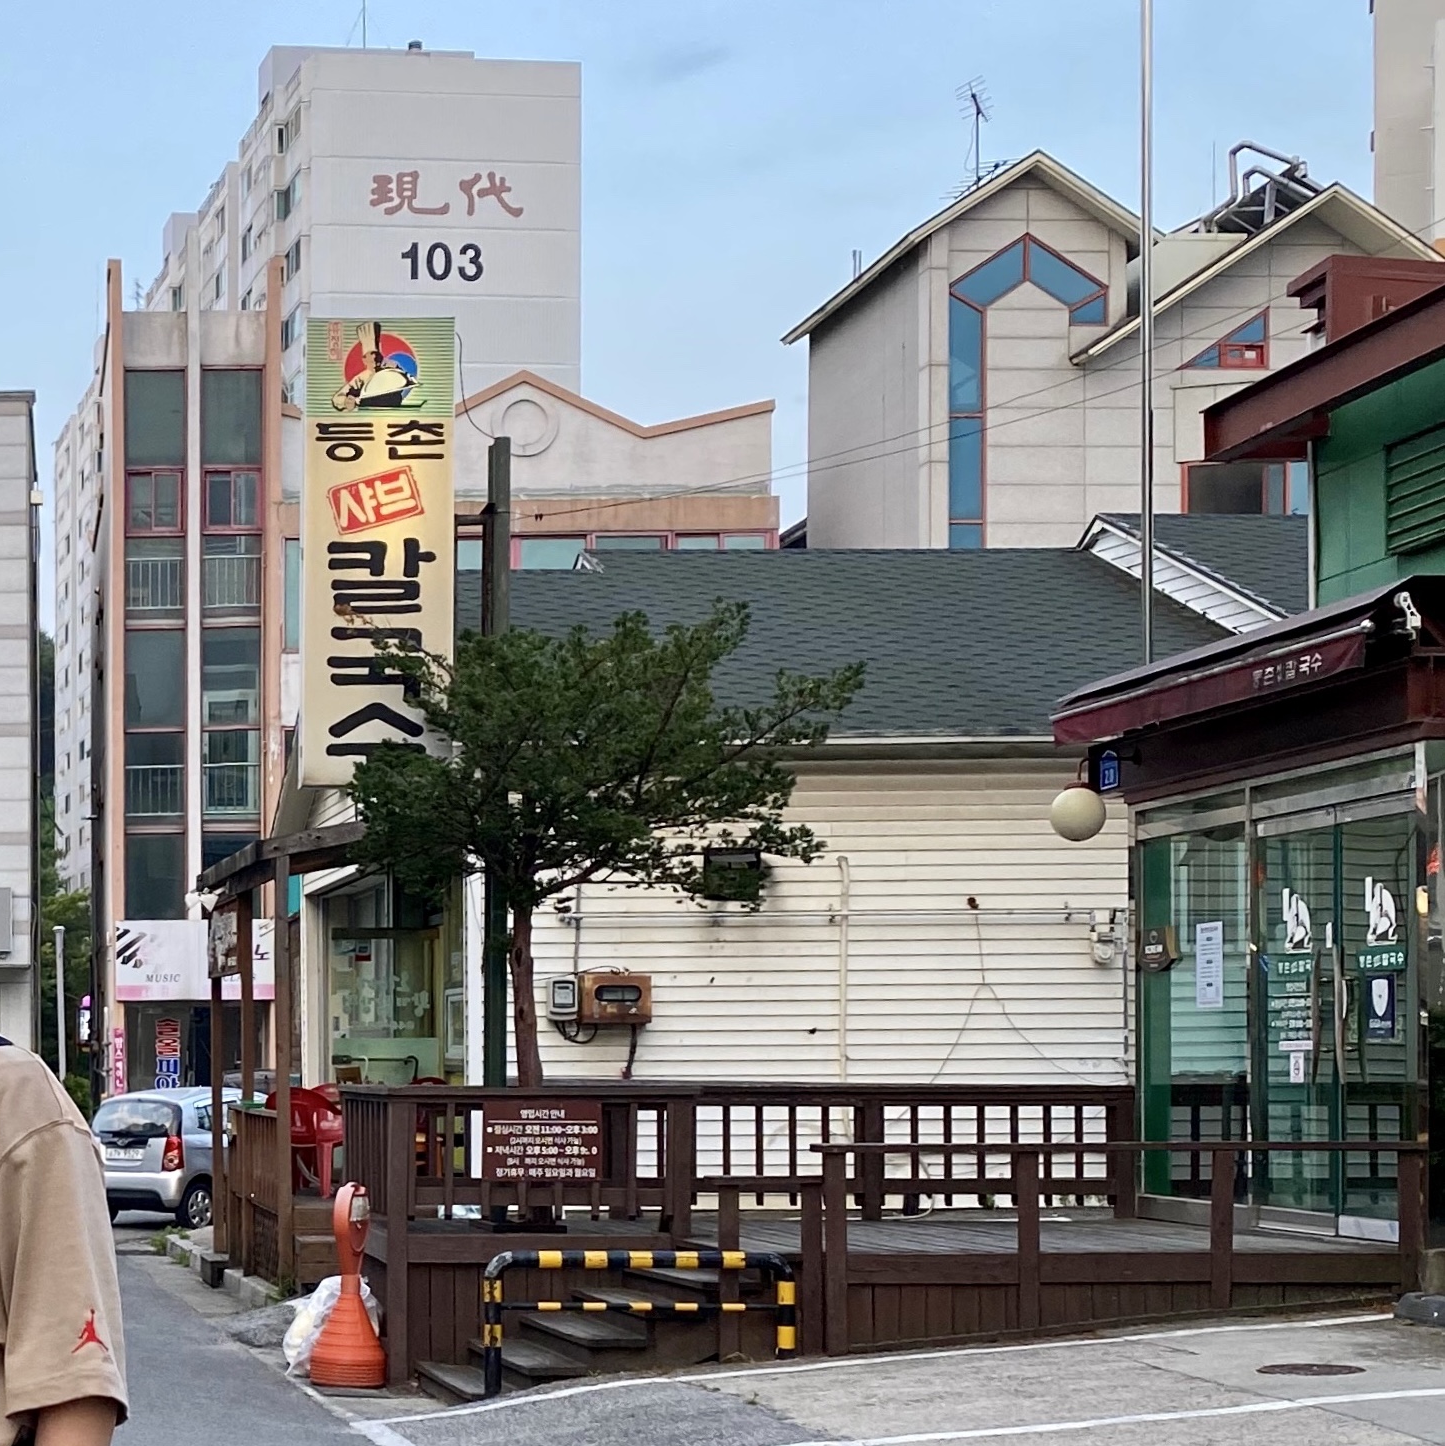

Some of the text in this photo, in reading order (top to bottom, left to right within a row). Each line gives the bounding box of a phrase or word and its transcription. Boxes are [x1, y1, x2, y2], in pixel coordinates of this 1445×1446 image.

[369, 170, 524, 218] 現代
[401, 241, 484, 282] 103
[315, 420, 445, 462] 등촌
[338, 472, 417, 529] 샤브
[326, 537, 436, 760] 칼국수
[145, 973, 181, 983] MUSIC
[520, 1109, 565, 1119] 영업시간 안내
[525, 1125, 540, 1134] 오전
